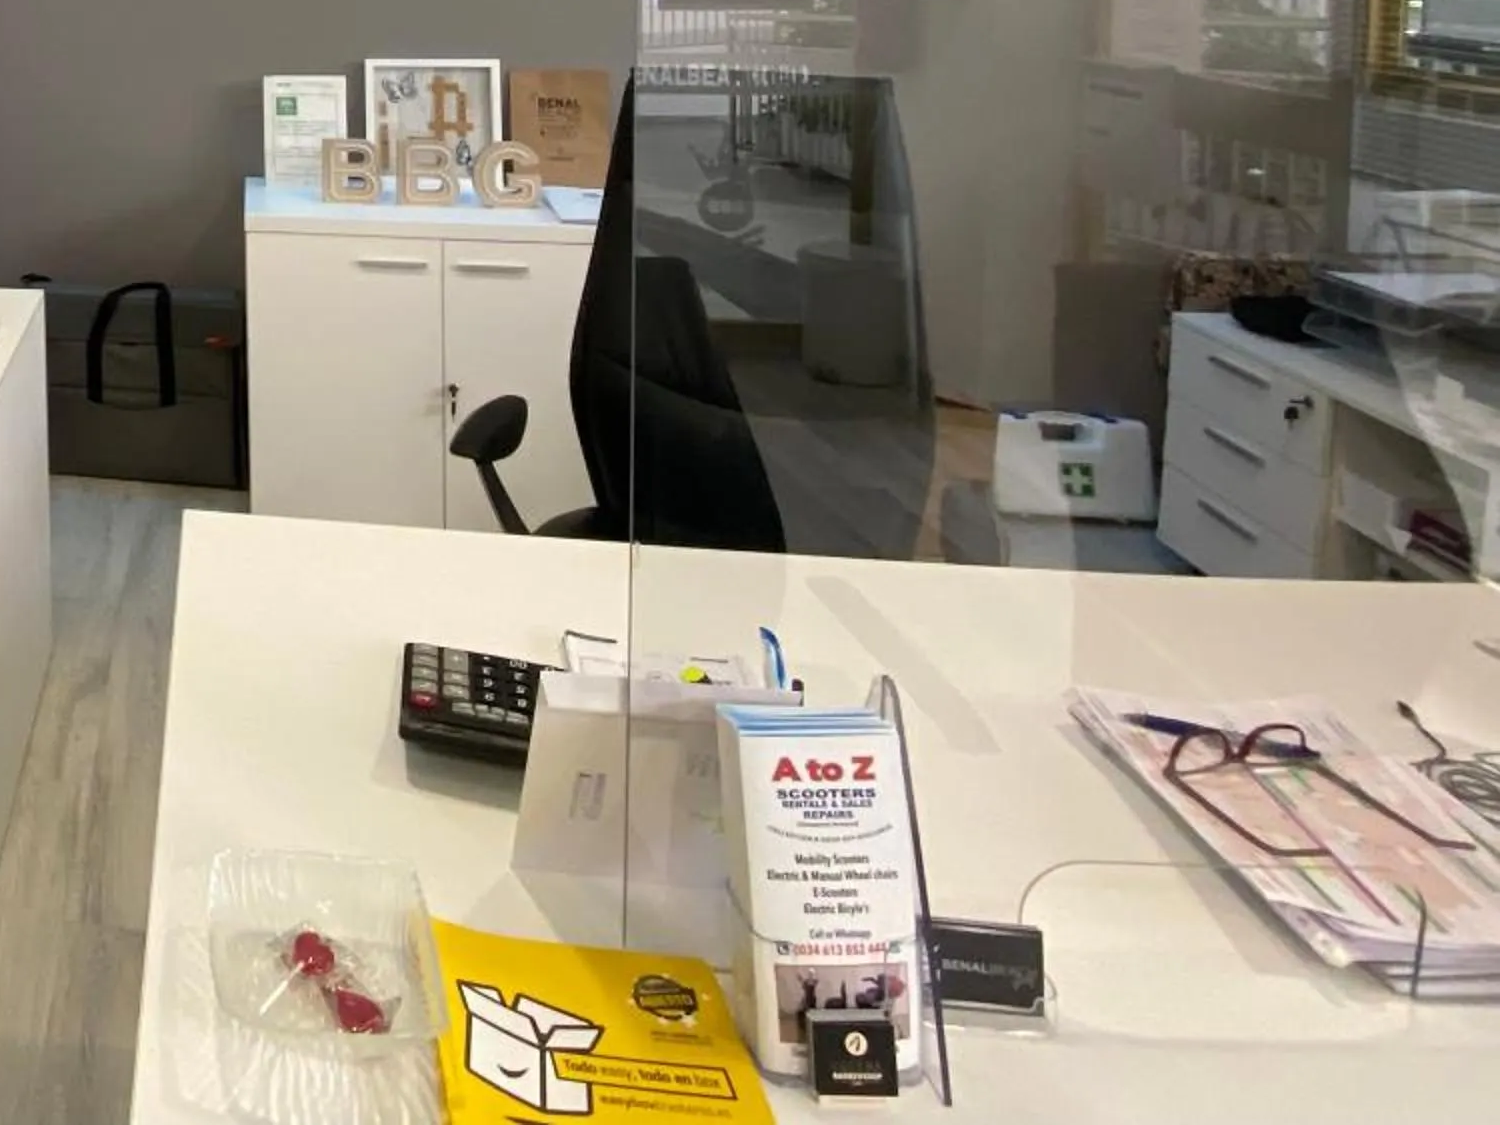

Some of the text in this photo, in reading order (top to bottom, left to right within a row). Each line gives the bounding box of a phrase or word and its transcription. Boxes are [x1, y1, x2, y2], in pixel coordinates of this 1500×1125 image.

[772, 756, 876, 782] A to Z
[776, 788, 877, 800] SCOOTERS
[842, 799, 873, 808] SALES
[803, 810, 854, 820] REPAIRS
[794, 853, 870, 867] Mobility Scooters
[767, 869, 799, 881] Electric
[811, 870, 842, 881] Manual
[845, 869, 872, 880] Wheel
[804, 902, 836, 914] Electric
